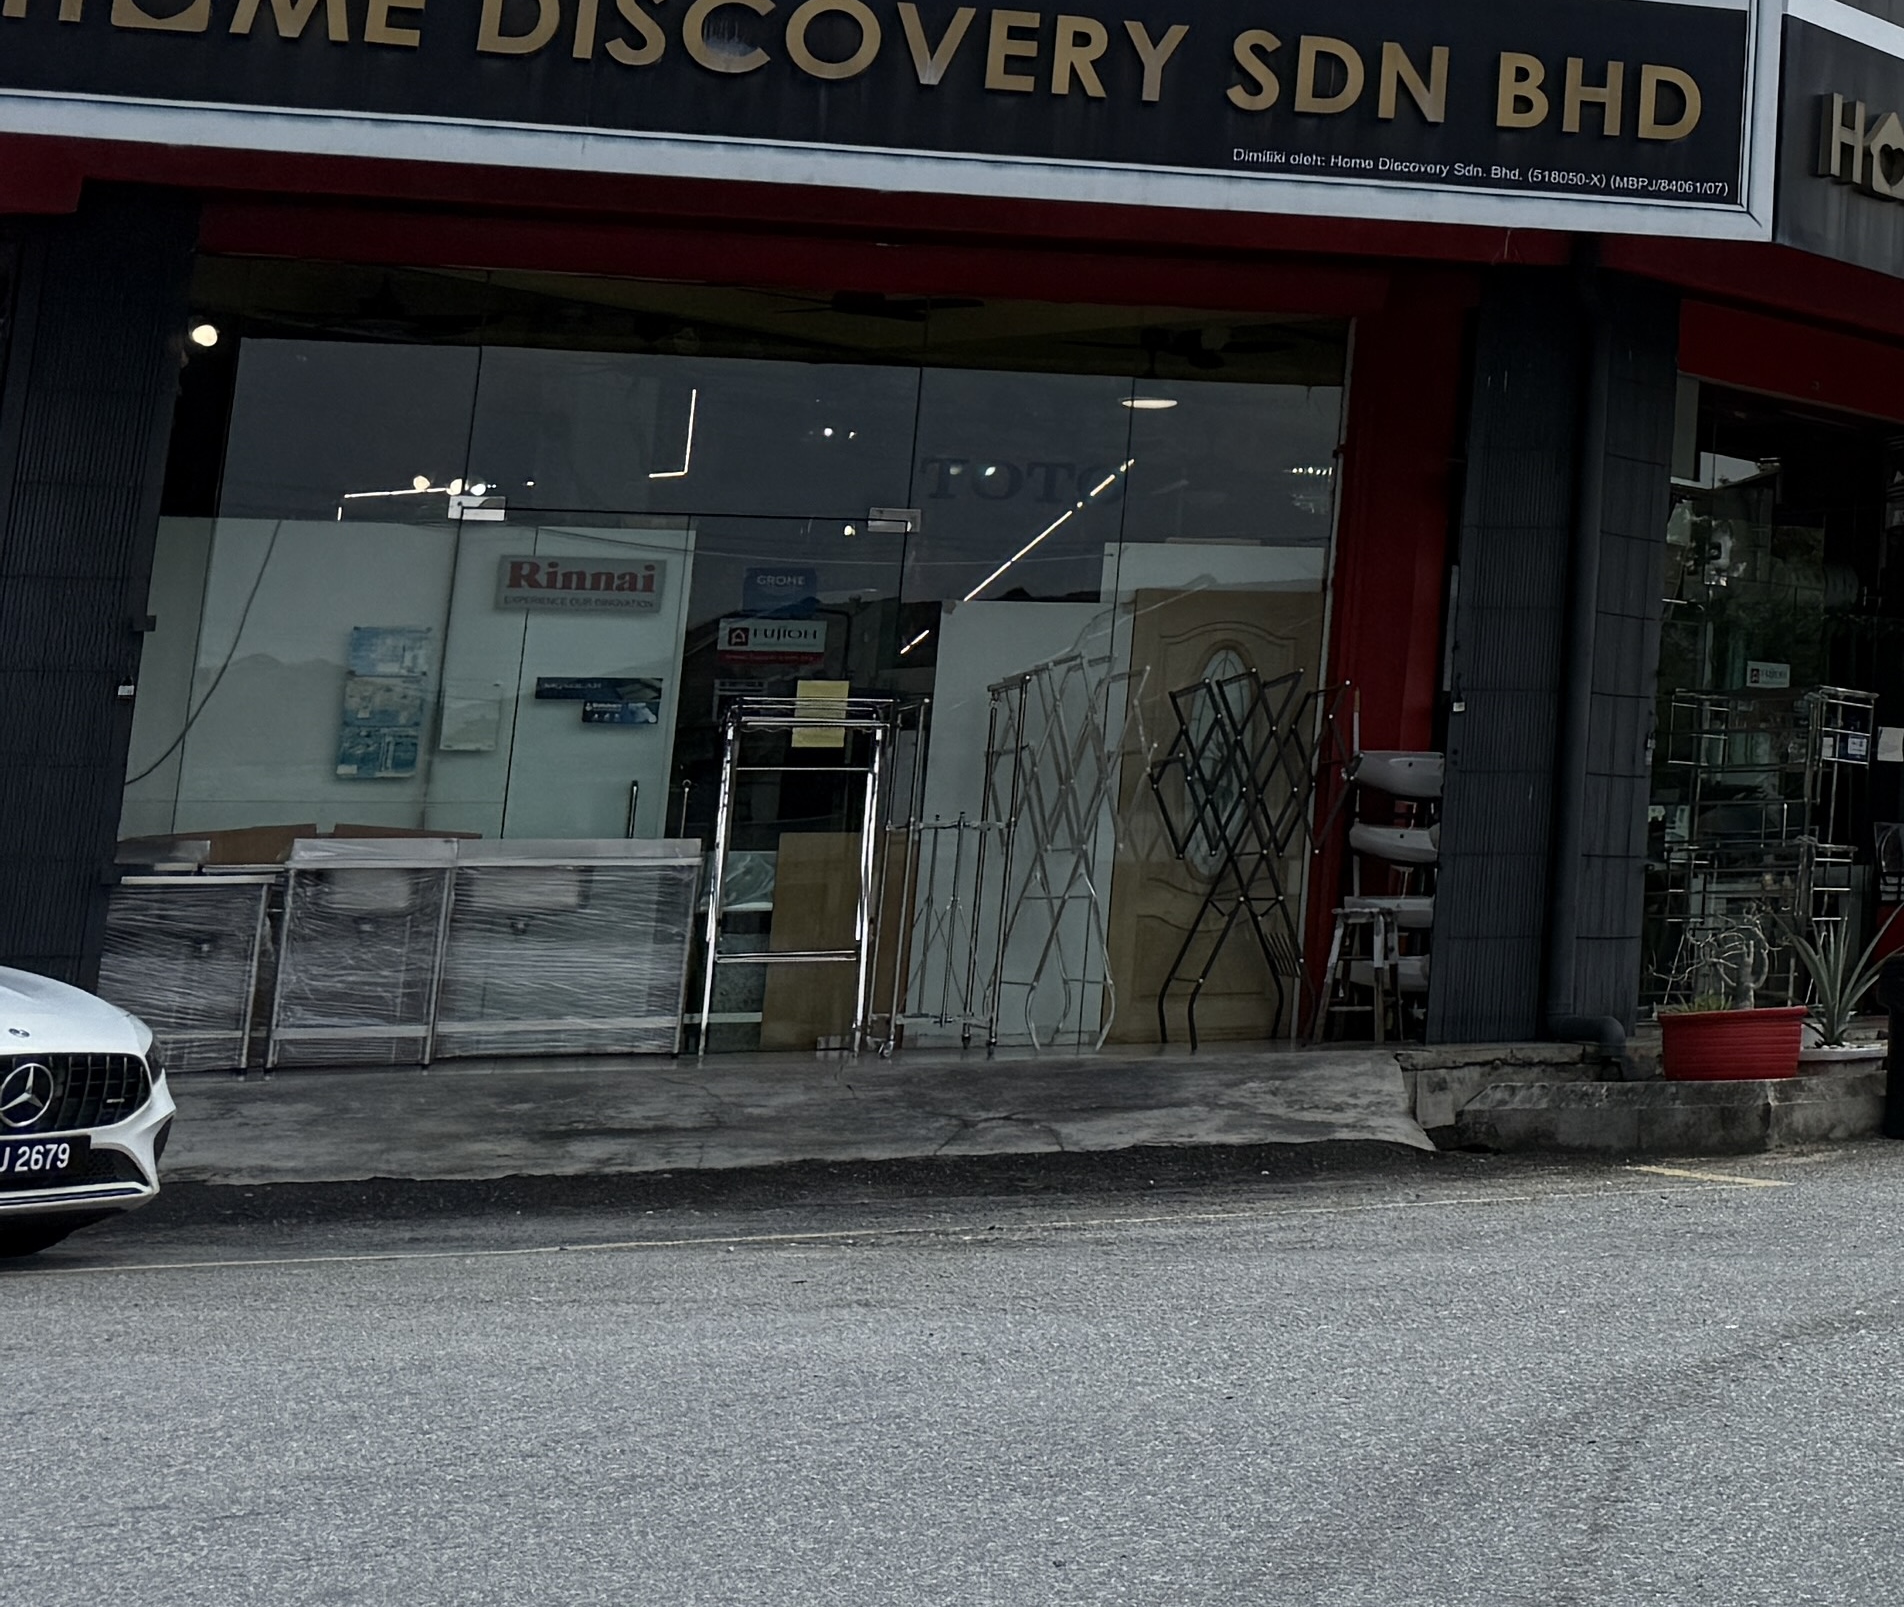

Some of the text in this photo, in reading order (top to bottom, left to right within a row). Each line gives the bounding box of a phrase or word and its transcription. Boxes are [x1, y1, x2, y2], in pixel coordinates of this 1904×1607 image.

[1226, 28, 1450, 124] SDN
[1496, 52, 1702, 142] BHD
[1233, 148, 1286, 164] Dimiliki
[1290, 152, 1326, 167] oleh:
[1330, 154, 1375, 169] Home
[1378, 157, 1450, 178] Discovery
[1453, 162, 1487, 178] Sdn.
[1491, 165, 1524, 182] Bhd.
[1527, 166, 1606, 189] (518050-X)
[507, 560, 656, 593] Rinnai
[756, 575, 805, 586] GROHE
[14, 1143, 70, 1173] 2679
